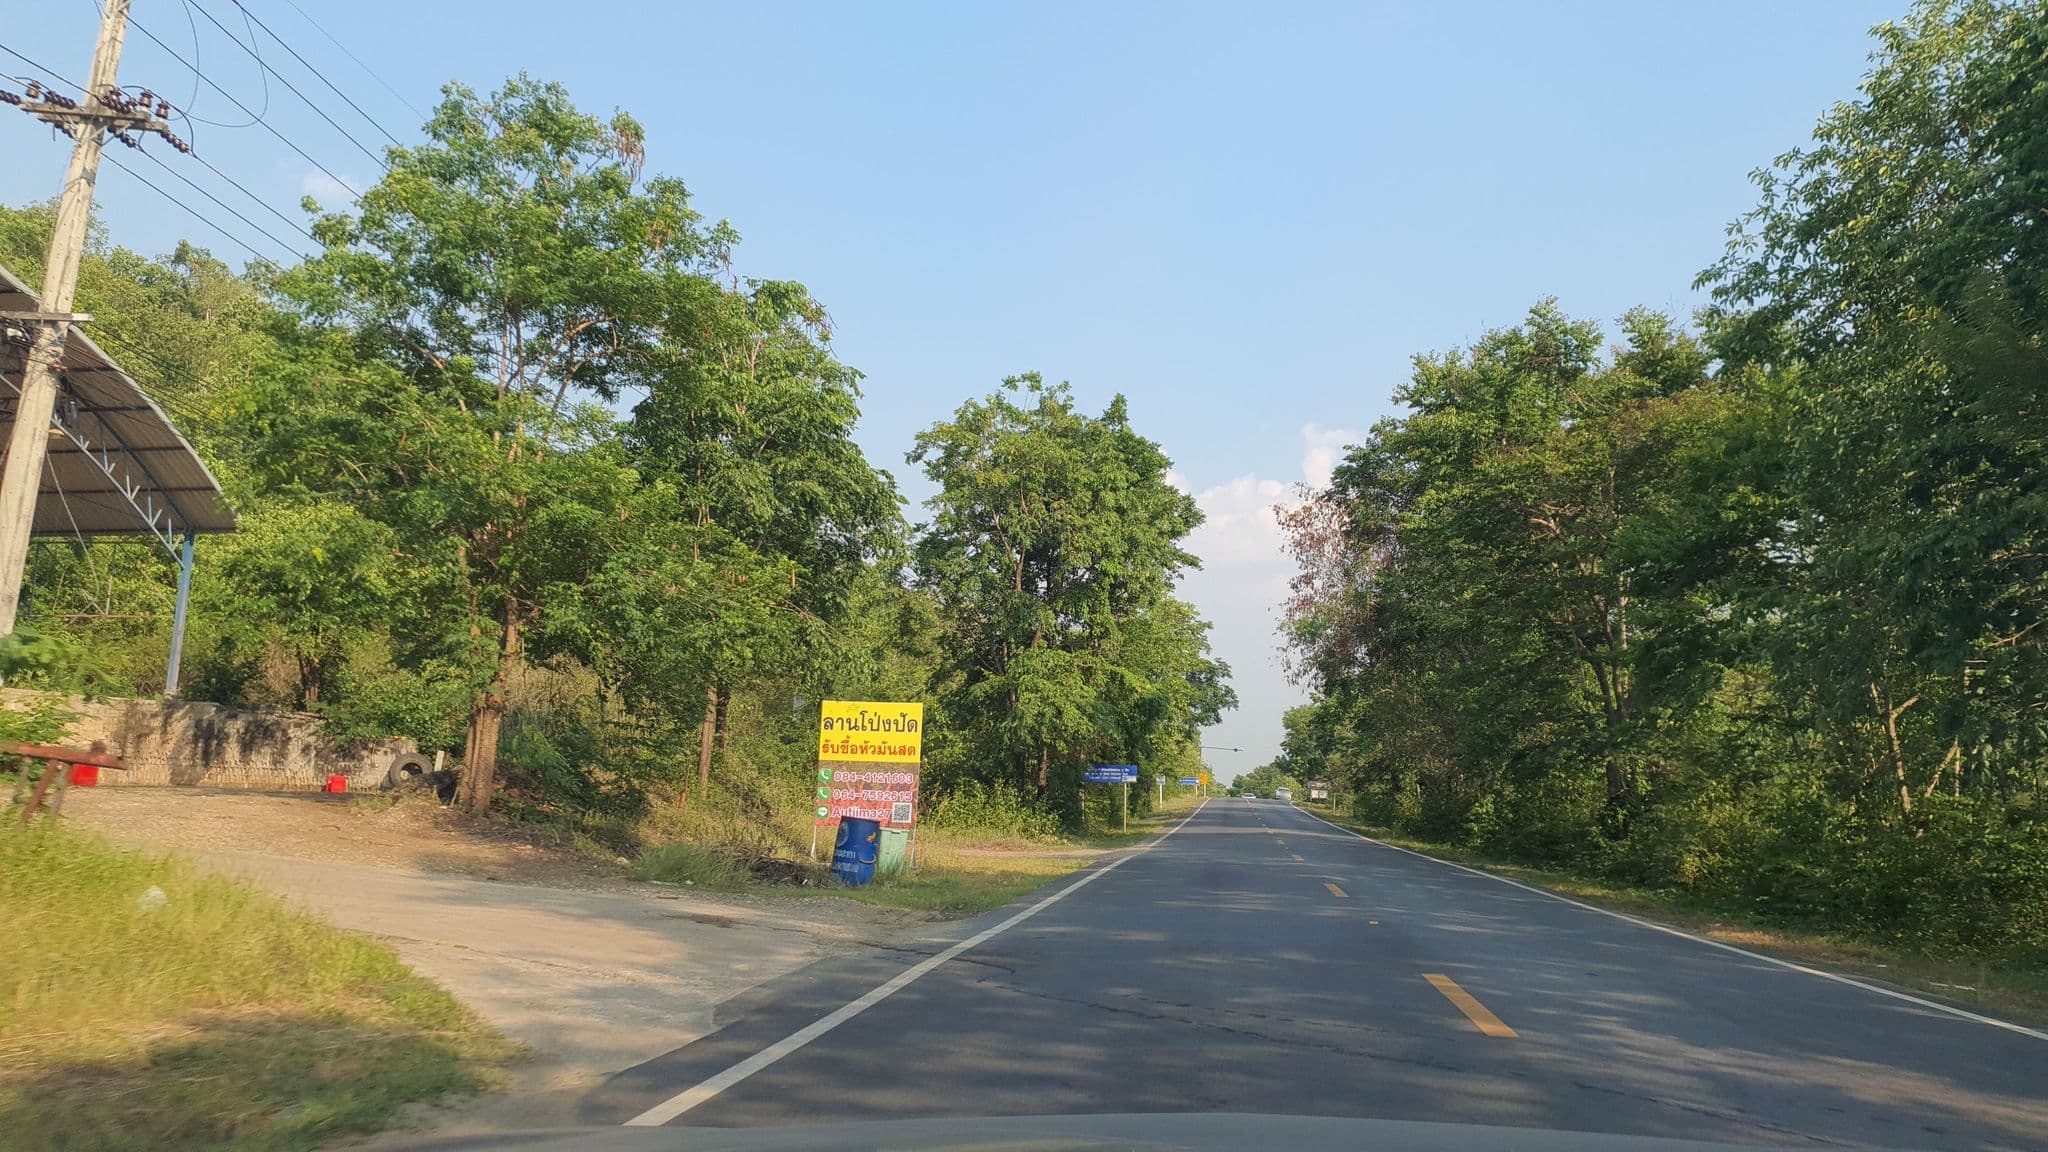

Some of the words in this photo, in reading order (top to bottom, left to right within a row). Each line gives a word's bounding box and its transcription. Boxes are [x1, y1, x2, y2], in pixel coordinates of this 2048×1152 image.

[823, 710, 918, 733] ลานโป่งปัด
[822, 736, 916, 756] รับซื้อหัวมันสด
